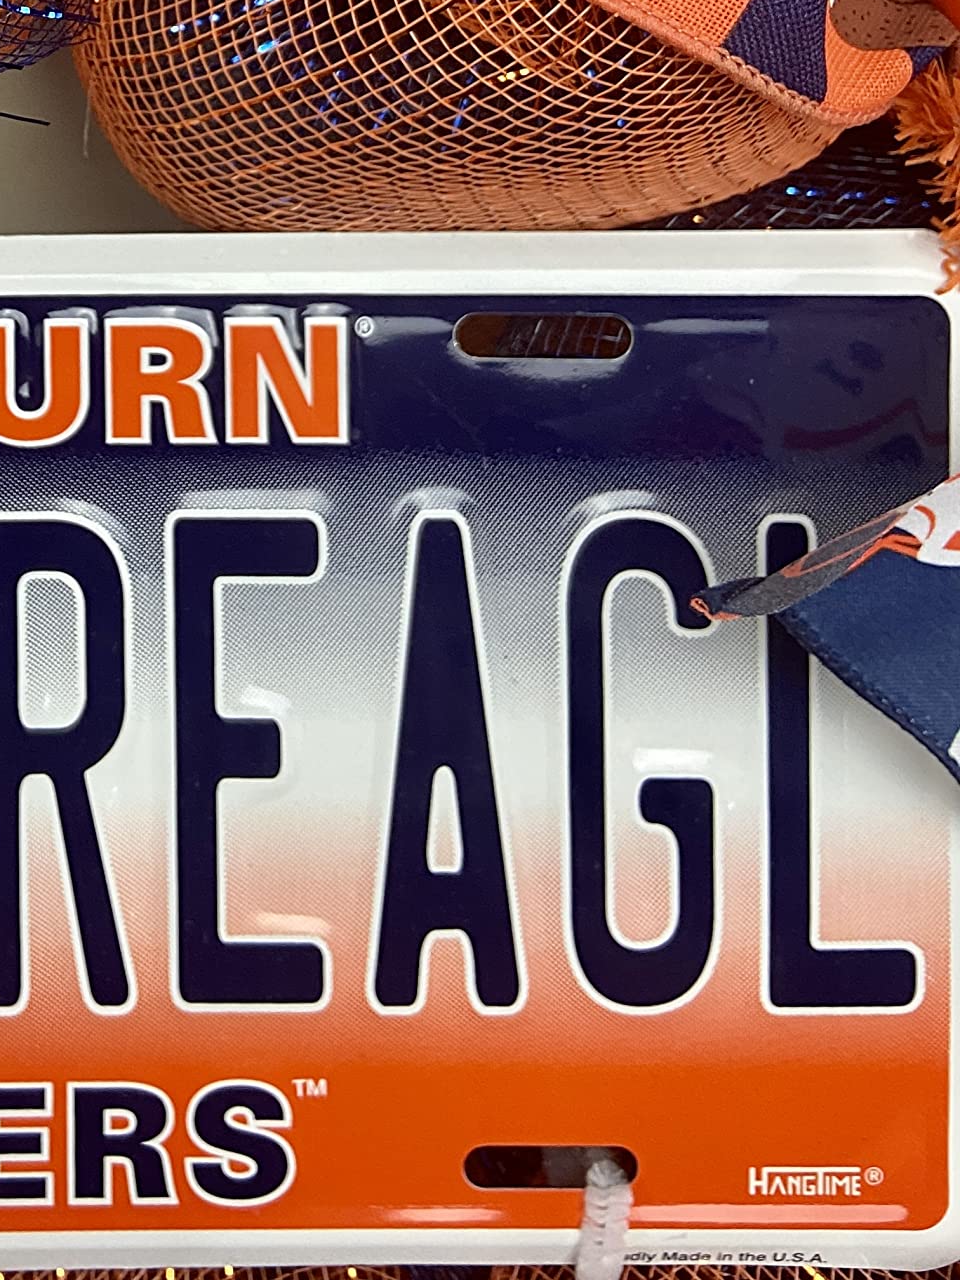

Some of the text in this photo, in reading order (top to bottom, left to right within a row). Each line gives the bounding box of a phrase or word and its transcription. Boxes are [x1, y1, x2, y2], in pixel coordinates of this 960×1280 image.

[662, 1251, 712, 1262] Made
[717, 1251, 733, 1262] in
[739, 1251, 767, 1262] the
[772, 1252, 828, 1264] U.S.A.
